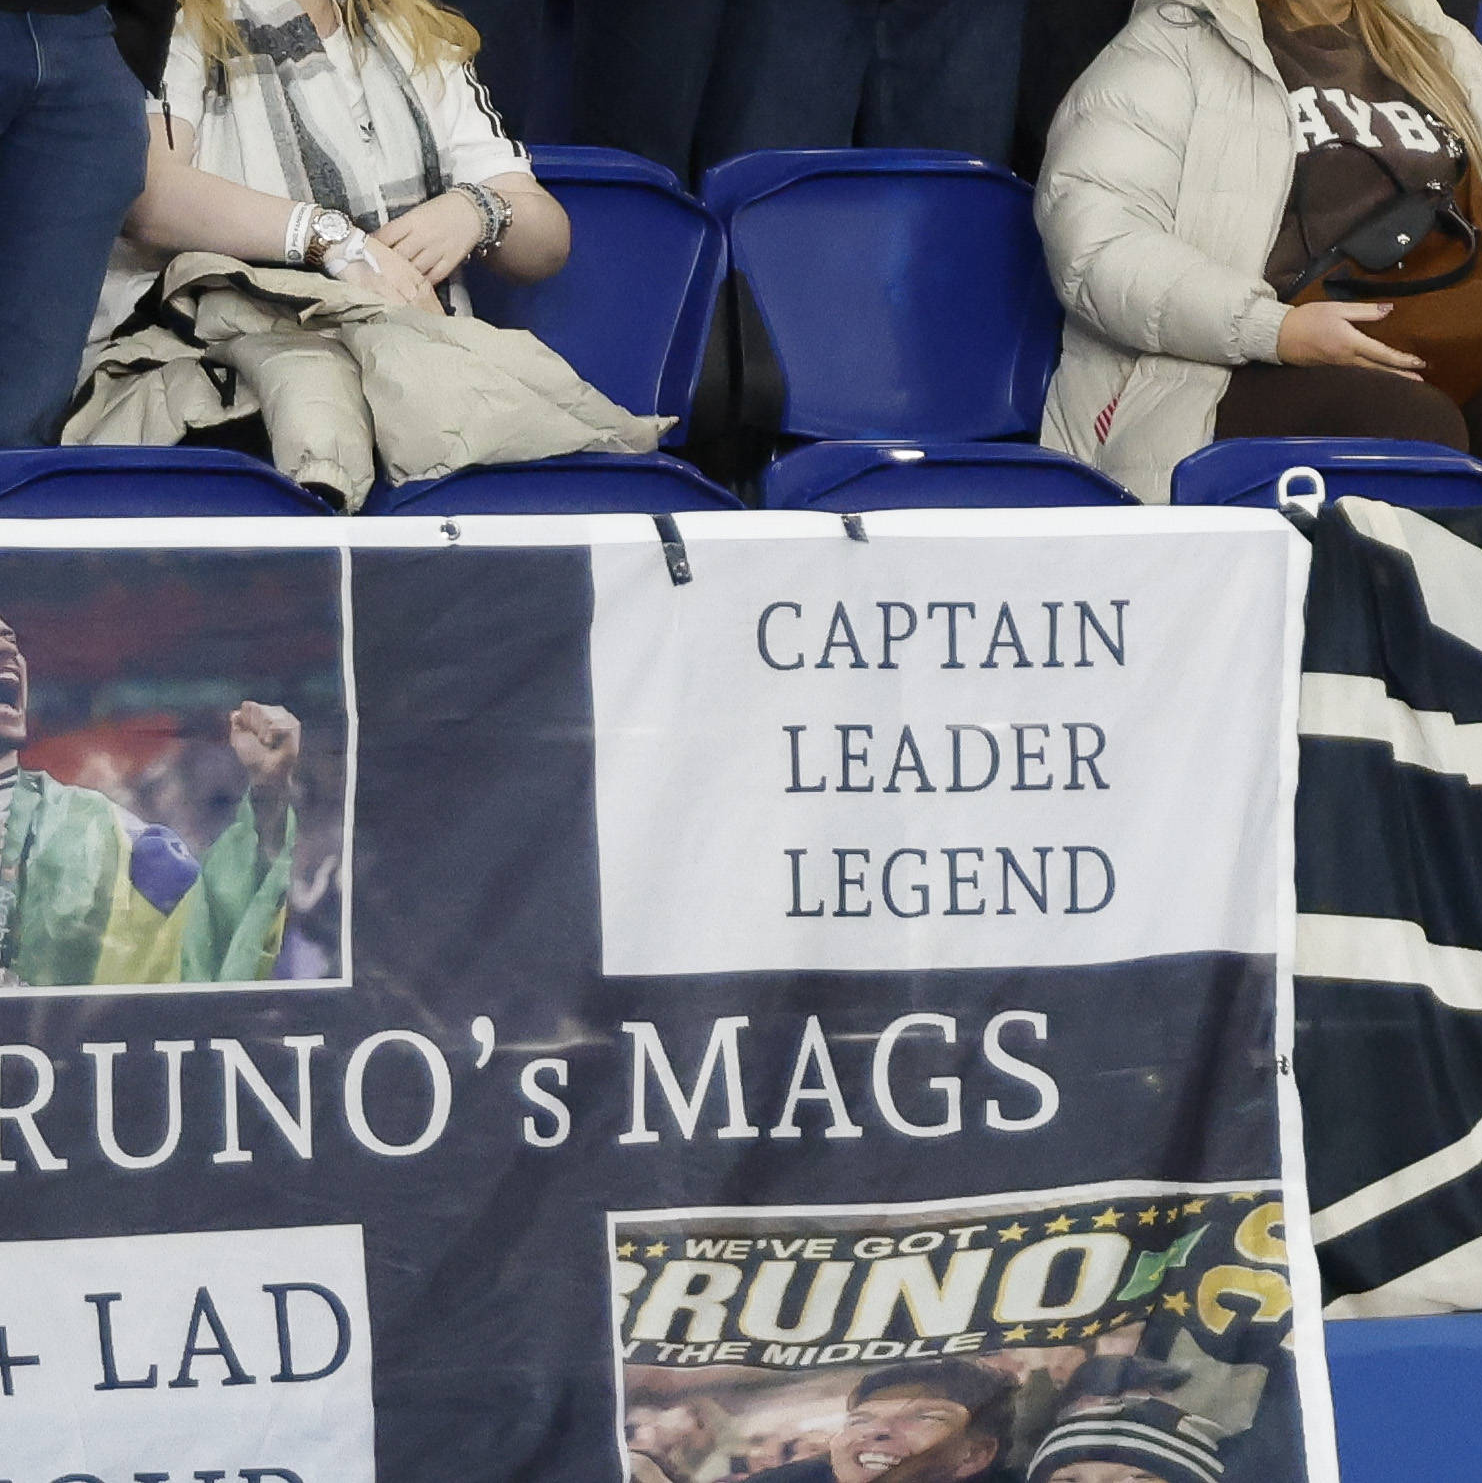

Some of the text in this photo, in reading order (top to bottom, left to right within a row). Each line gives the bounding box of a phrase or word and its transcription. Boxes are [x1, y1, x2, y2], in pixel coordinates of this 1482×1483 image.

[757, 599, 1130, 670] CAPTAIN
[783, 722, 1110, 793] LEADER
[784, 846, 1116, 918] LEGEND
[619, 1010, 1060, 1144] MAGS
[684, 1225, 988, 1260] WE'VE GOT
[84, 1282, 352, 1391] LAD
[656, 1340, 752, 1364] THE
[761, 1330, 988, 1366] MIDDLE
